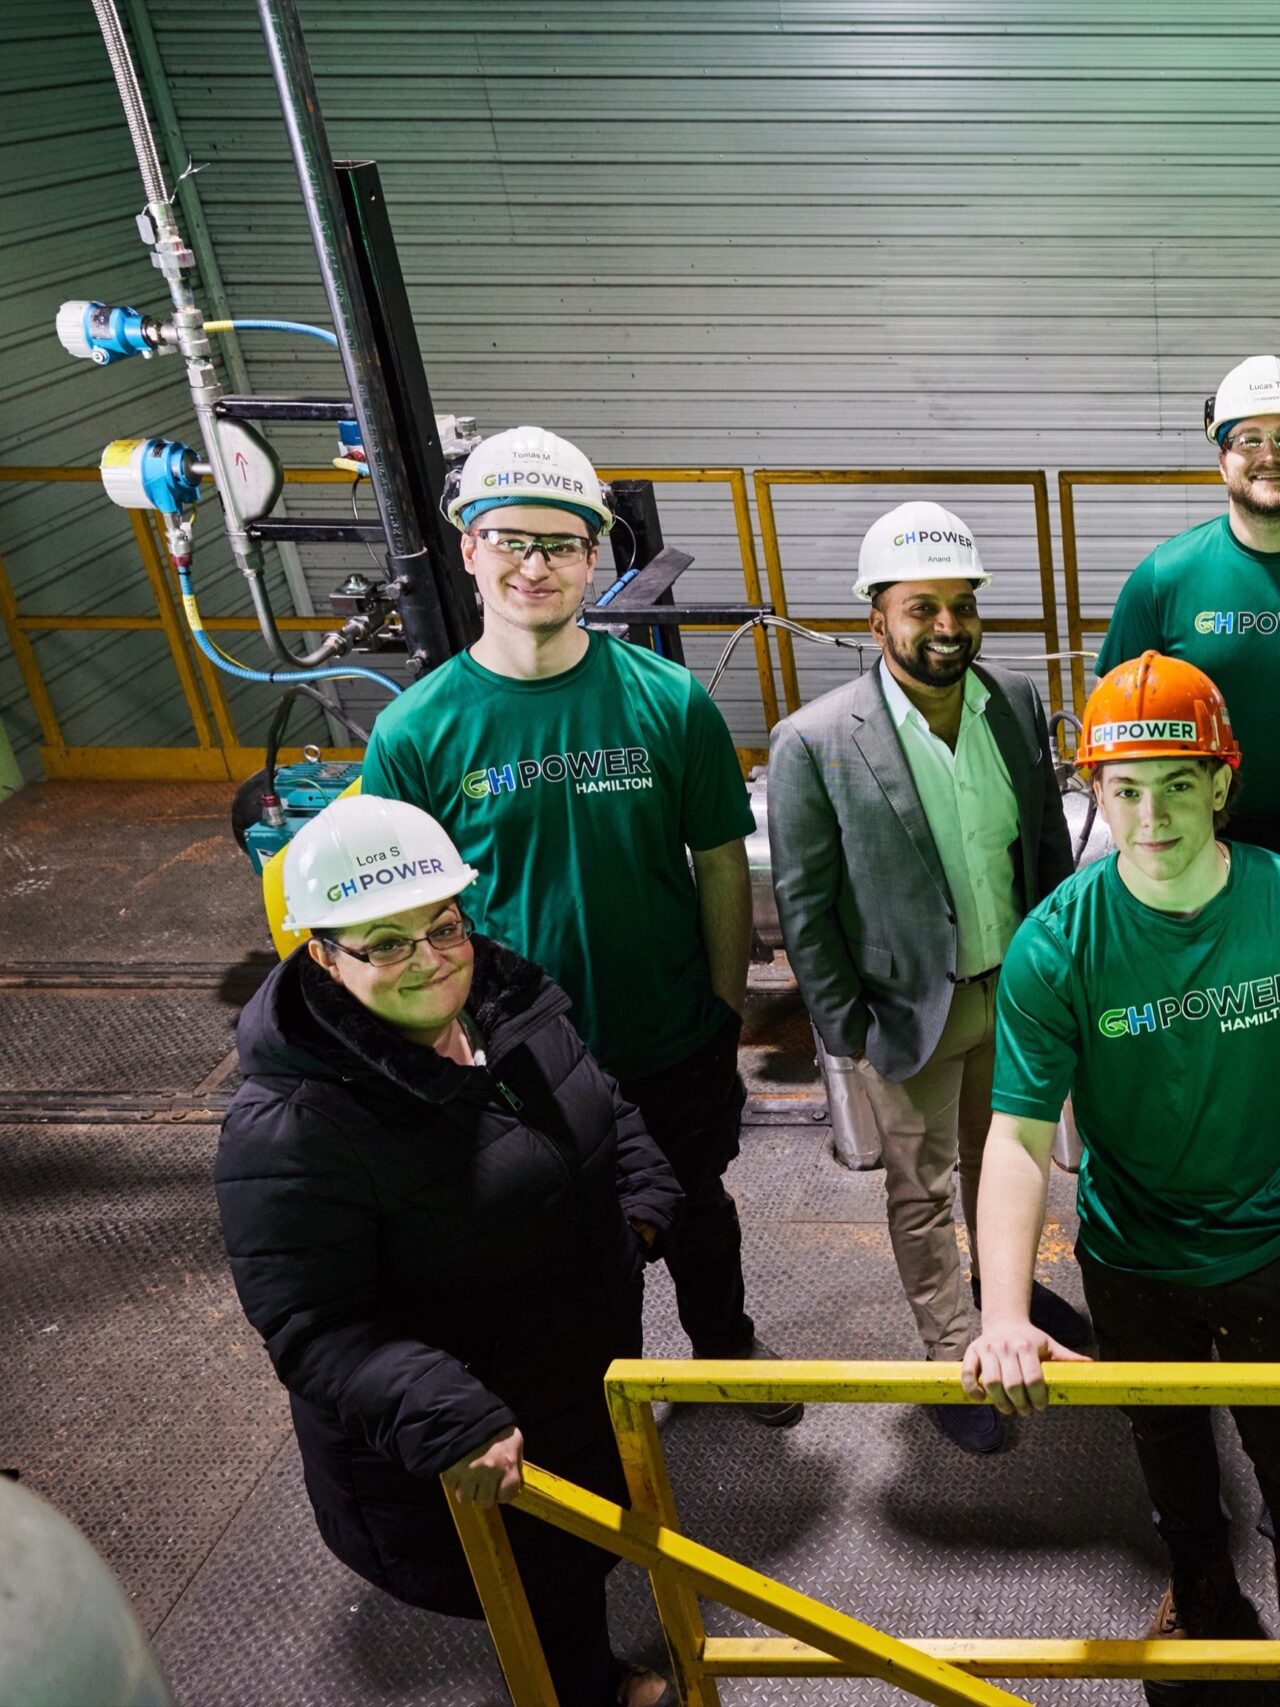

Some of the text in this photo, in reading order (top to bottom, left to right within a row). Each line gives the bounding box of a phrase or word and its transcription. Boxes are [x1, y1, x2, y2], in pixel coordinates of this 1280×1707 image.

[513, 451, 541, 459] Tomas
[576, 777, 653, 794] HAMILTON
[356, 846, 400, 867] Lora S
